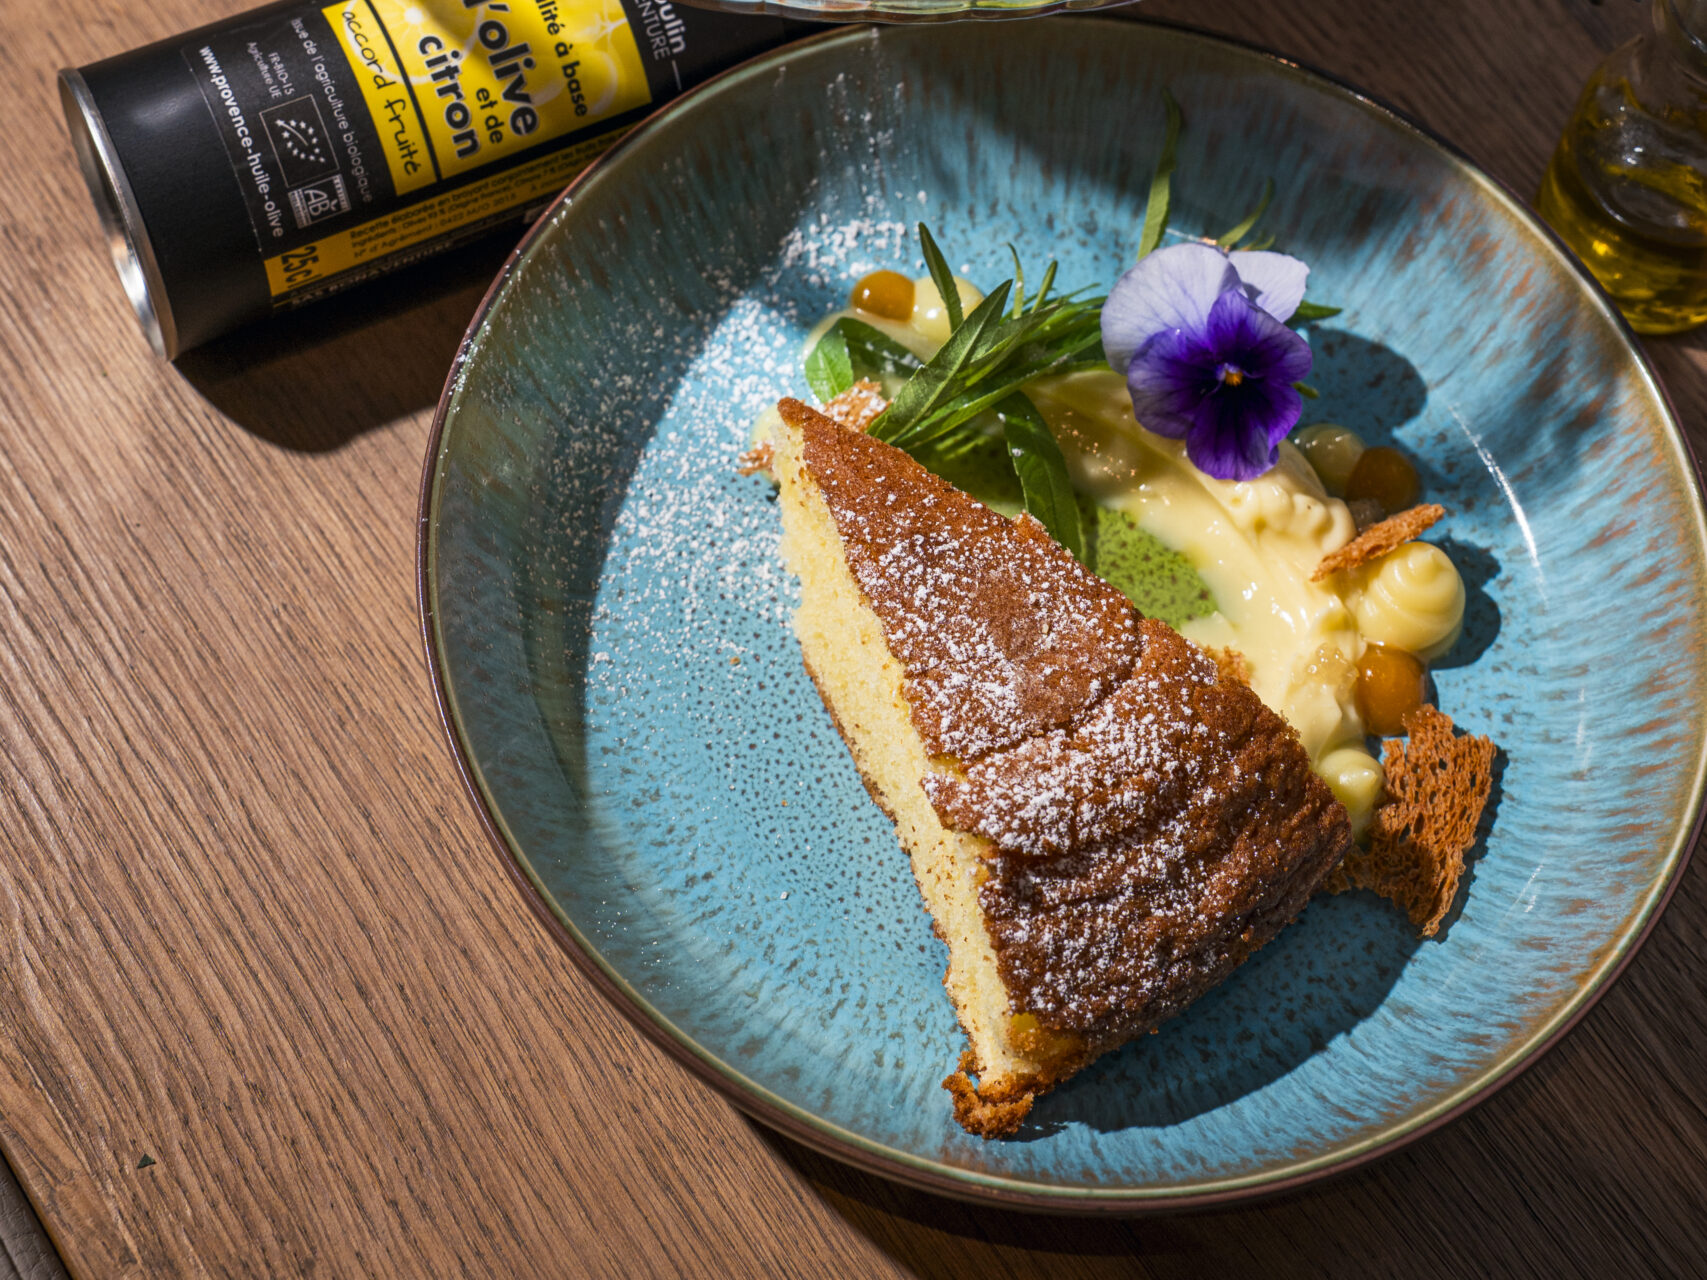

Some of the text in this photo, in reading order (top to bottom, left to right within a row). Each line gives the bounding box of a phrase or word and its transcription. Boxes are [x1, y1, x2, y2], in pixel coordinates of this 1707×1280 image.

[555, 42, 573, 58] à
[654, 0, 686, 54] ulin
[247, 42, 282, 99] Agriculture UE
[268, 52, 295, 95] FR-BIO-15
[342, 11, 421, 176] accord fruité
[418, 35, 481, 159] citron
[562, 61, 588, 117] base
[303, 40, 317, 55] de
[311, 55, 349, 130] l'agriculture
[343, 131, 373, 202] biologique
[476, 88, 505, 144] et de
[304, 189, 330, 216] AB
